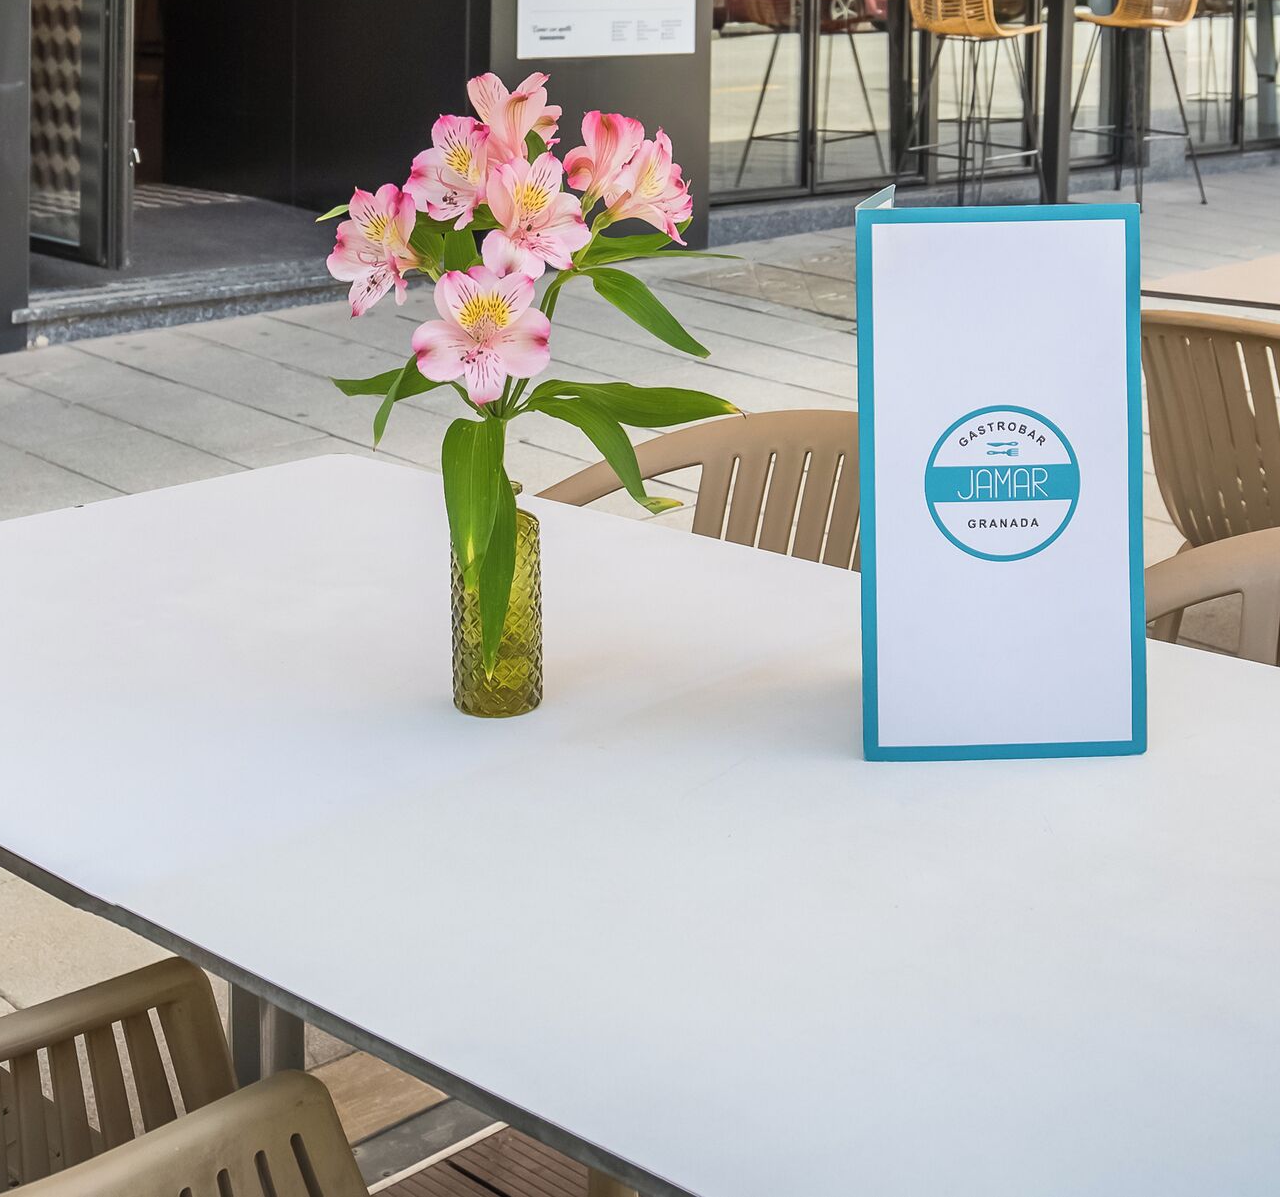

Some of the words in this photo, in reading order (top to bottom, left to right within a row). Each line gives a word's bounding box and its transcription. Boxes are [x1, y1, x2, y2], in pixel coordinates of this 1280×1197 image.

[958, 421, 1047, 448] GASTROBAR
[957, 467, 1049, 500] JAMAR
[967, 518, 1040, 529] GRANADA
